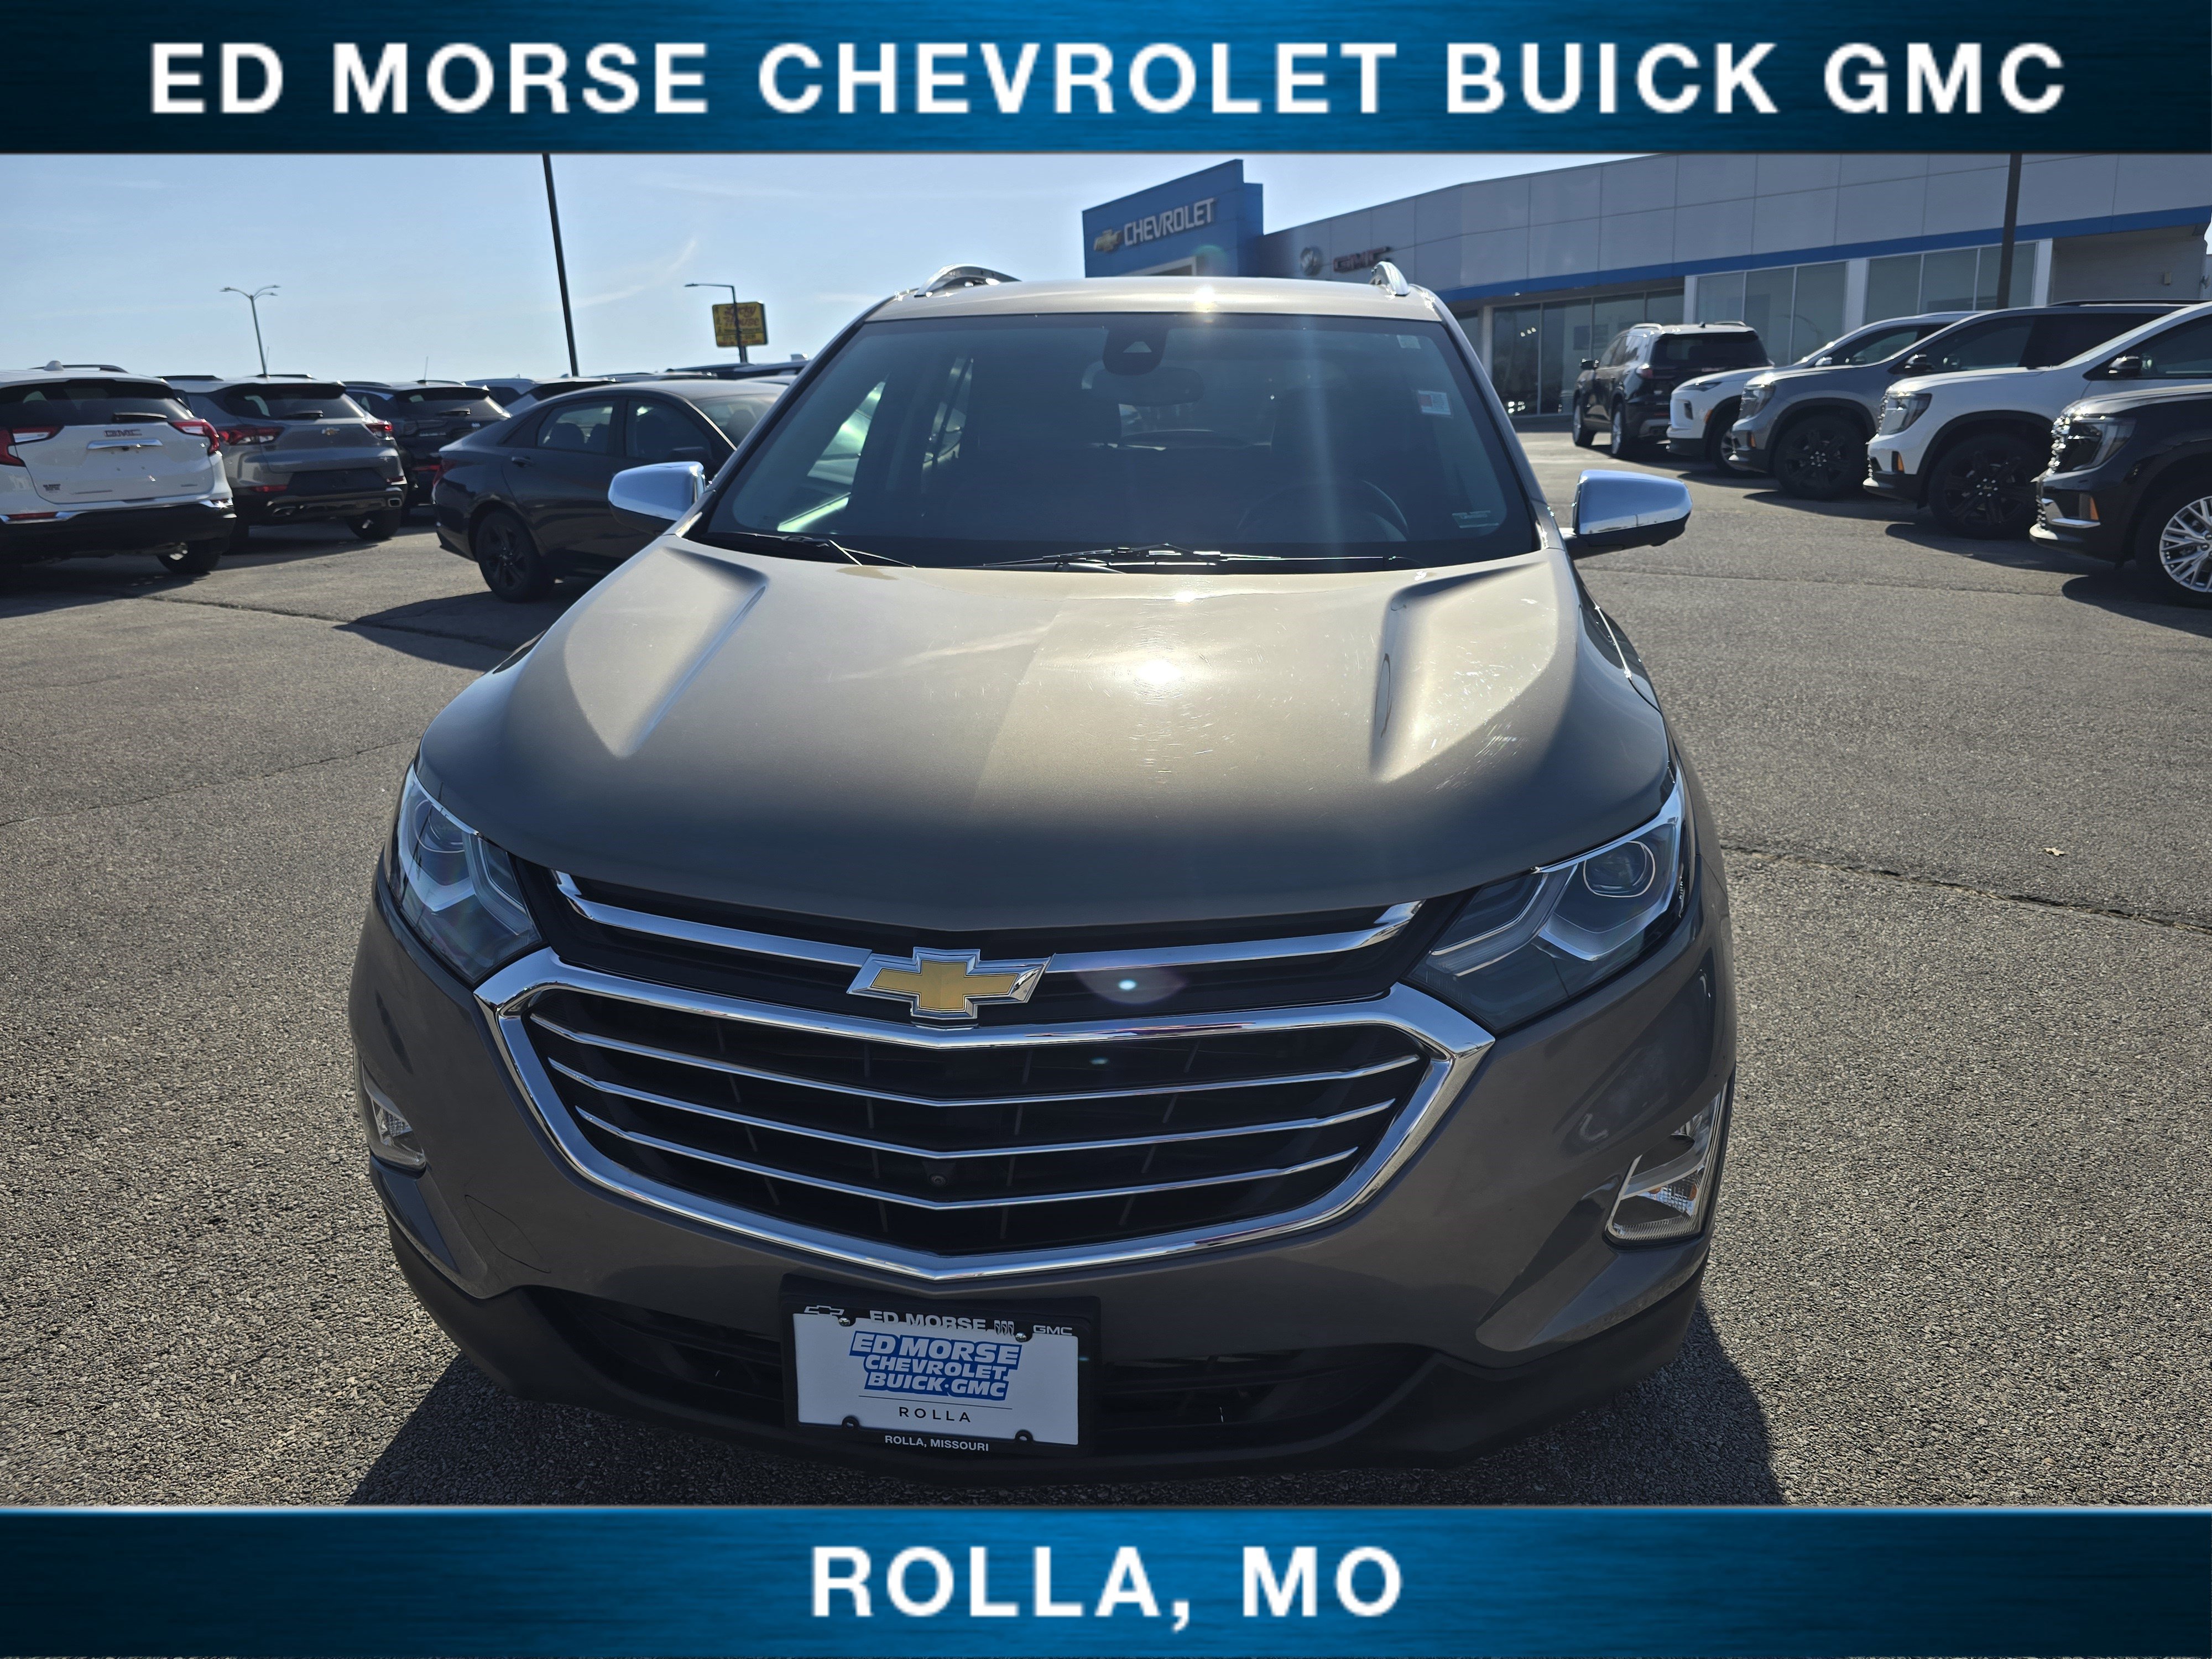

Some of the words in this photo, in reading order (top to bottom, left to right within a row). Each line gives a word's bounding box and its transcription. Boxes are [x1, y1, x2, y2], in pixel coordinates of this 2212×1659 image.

[1124, 197, 1215, 247] CHEVROLET
[1333, 247, 1392, 273] GMC
[103, 429, 143, 437] GMC
[869, 1310, 899, 1325] ED
[905, 1313, 987, 1332] MORSE
[1033, 1324, 1073, 1336] GMC
[852, 1332, 896, 1354] ED
[899, 1336, 1020, 1365] MORSE
[865, 1354, 1007, 1380] CHEVROLET
[899, 1406, 971, 1423] ROLLA
[885, 1435, 927, 1448] ROLLA,
[930, 1438, 989, 1452] MISSOURI
